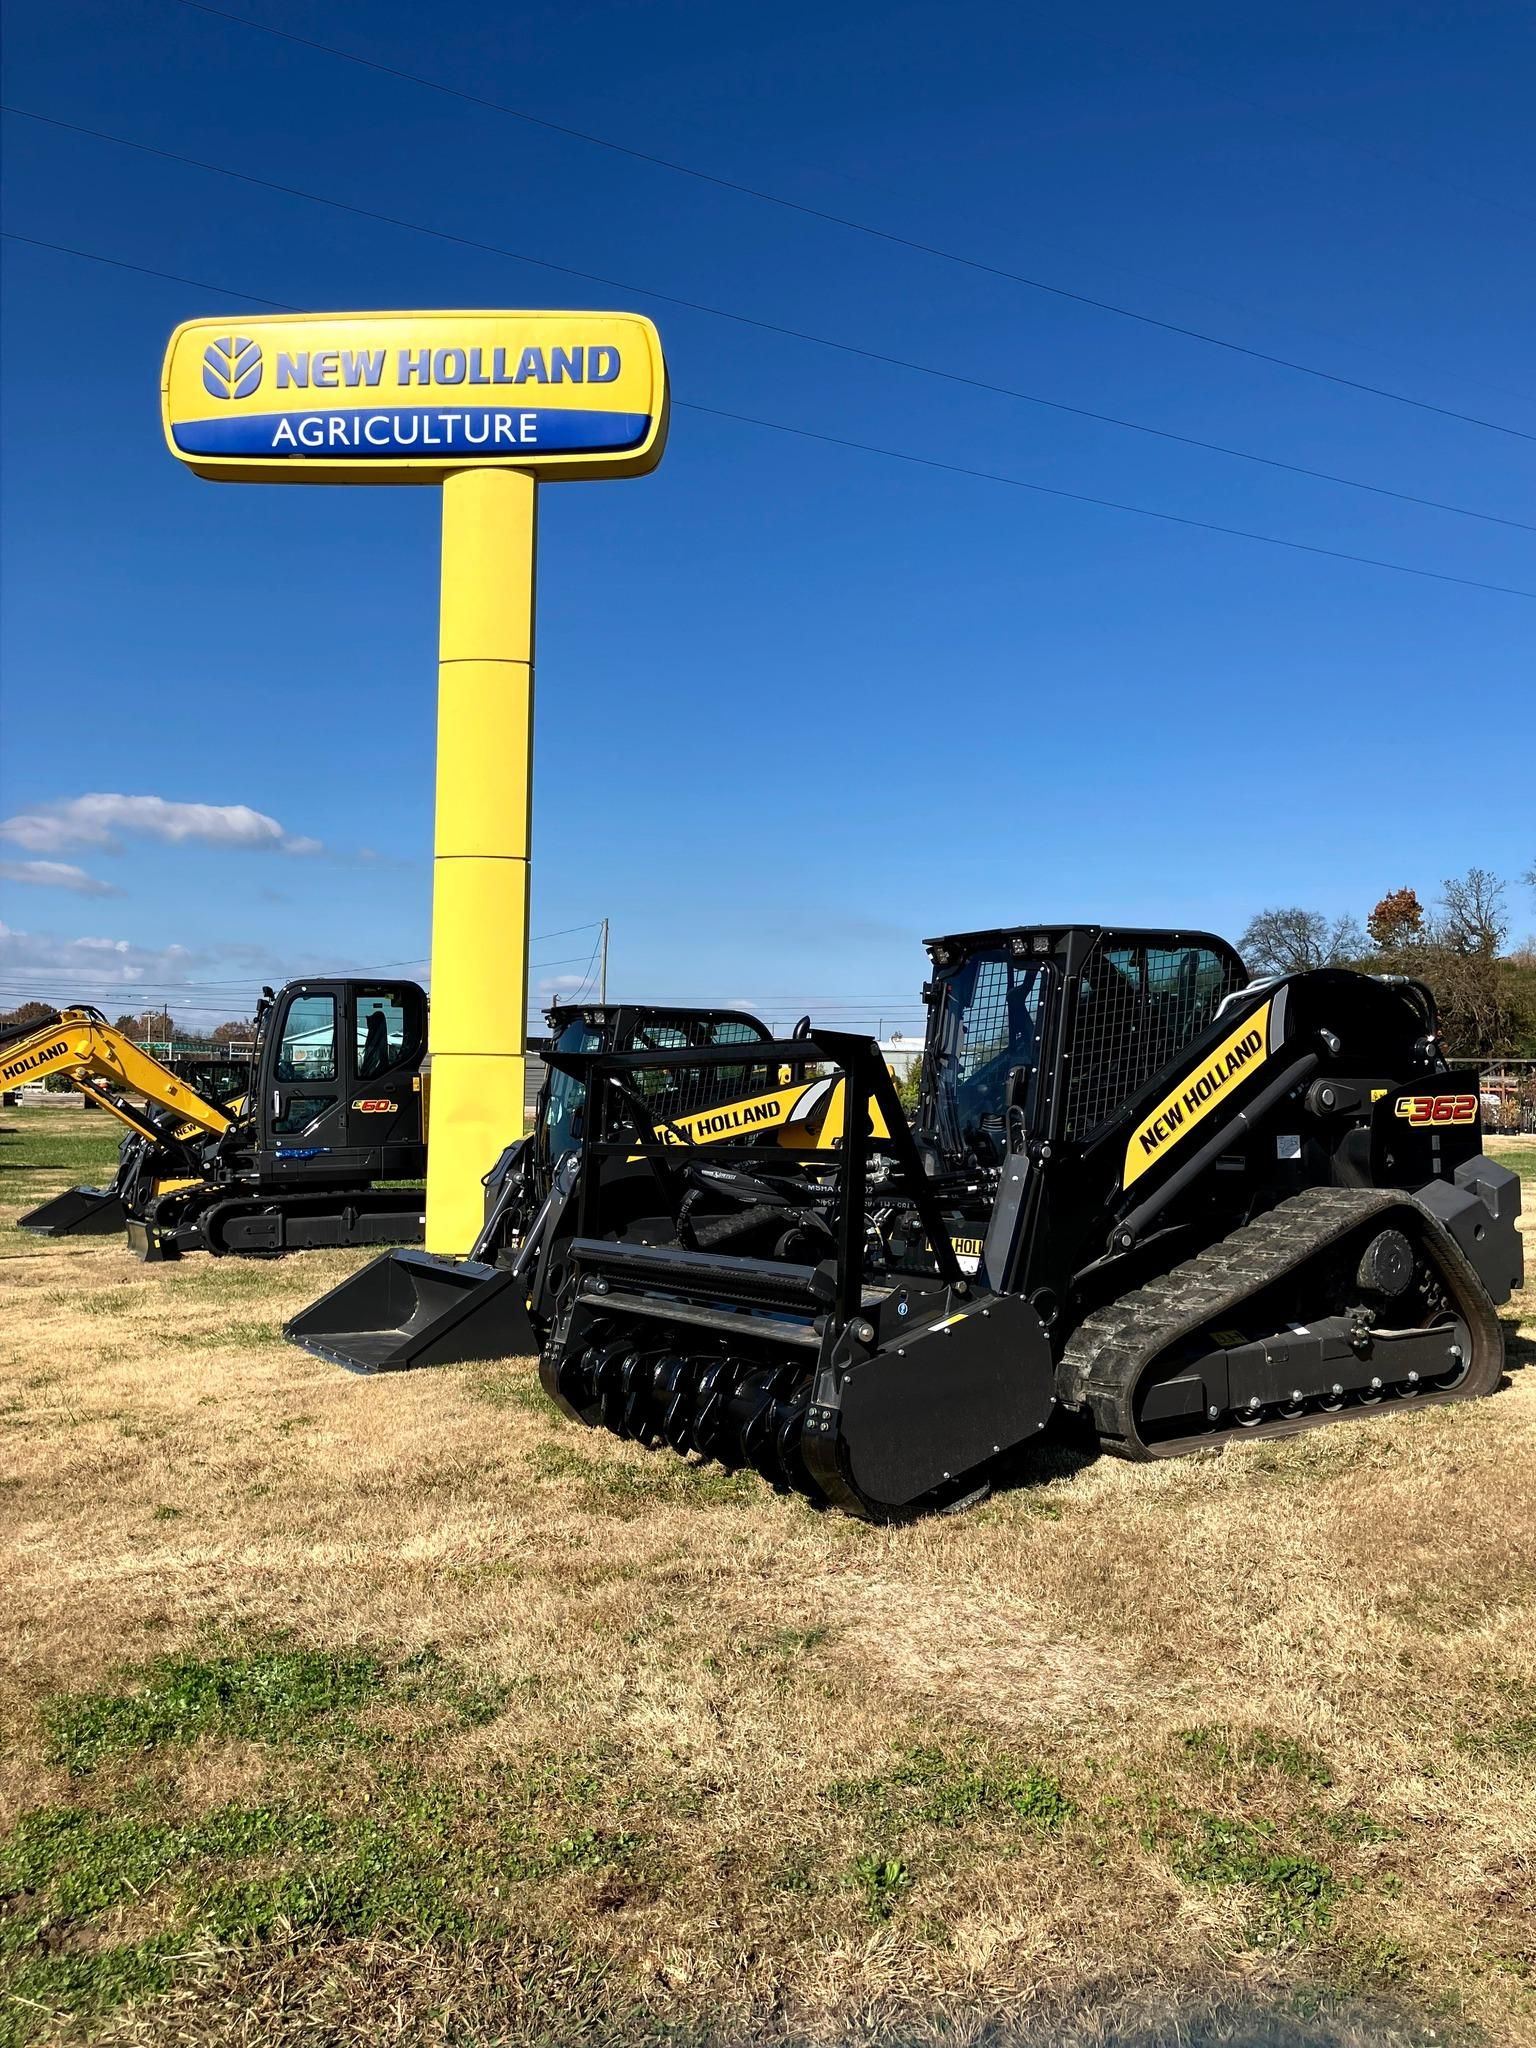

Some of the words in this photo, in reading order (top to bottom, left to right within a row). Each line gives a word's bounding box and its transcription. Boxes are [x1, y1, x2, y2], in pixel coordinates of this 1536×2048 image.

[276, 350, 386, 388] NEW
[397, 346, 621, 386] HOLLAND
[271, 413, 537, 447] AGRICULTURE
[2, 1041, 69, 1080] HOLLAND
[1139, 1101, 1186, 1155] NEW
[1182, 1029, 1262, 1115] HOLLAND
[1395, 1095, 1478, 1126] C362
[697, 1100, 781, 1137] HOLLAND
